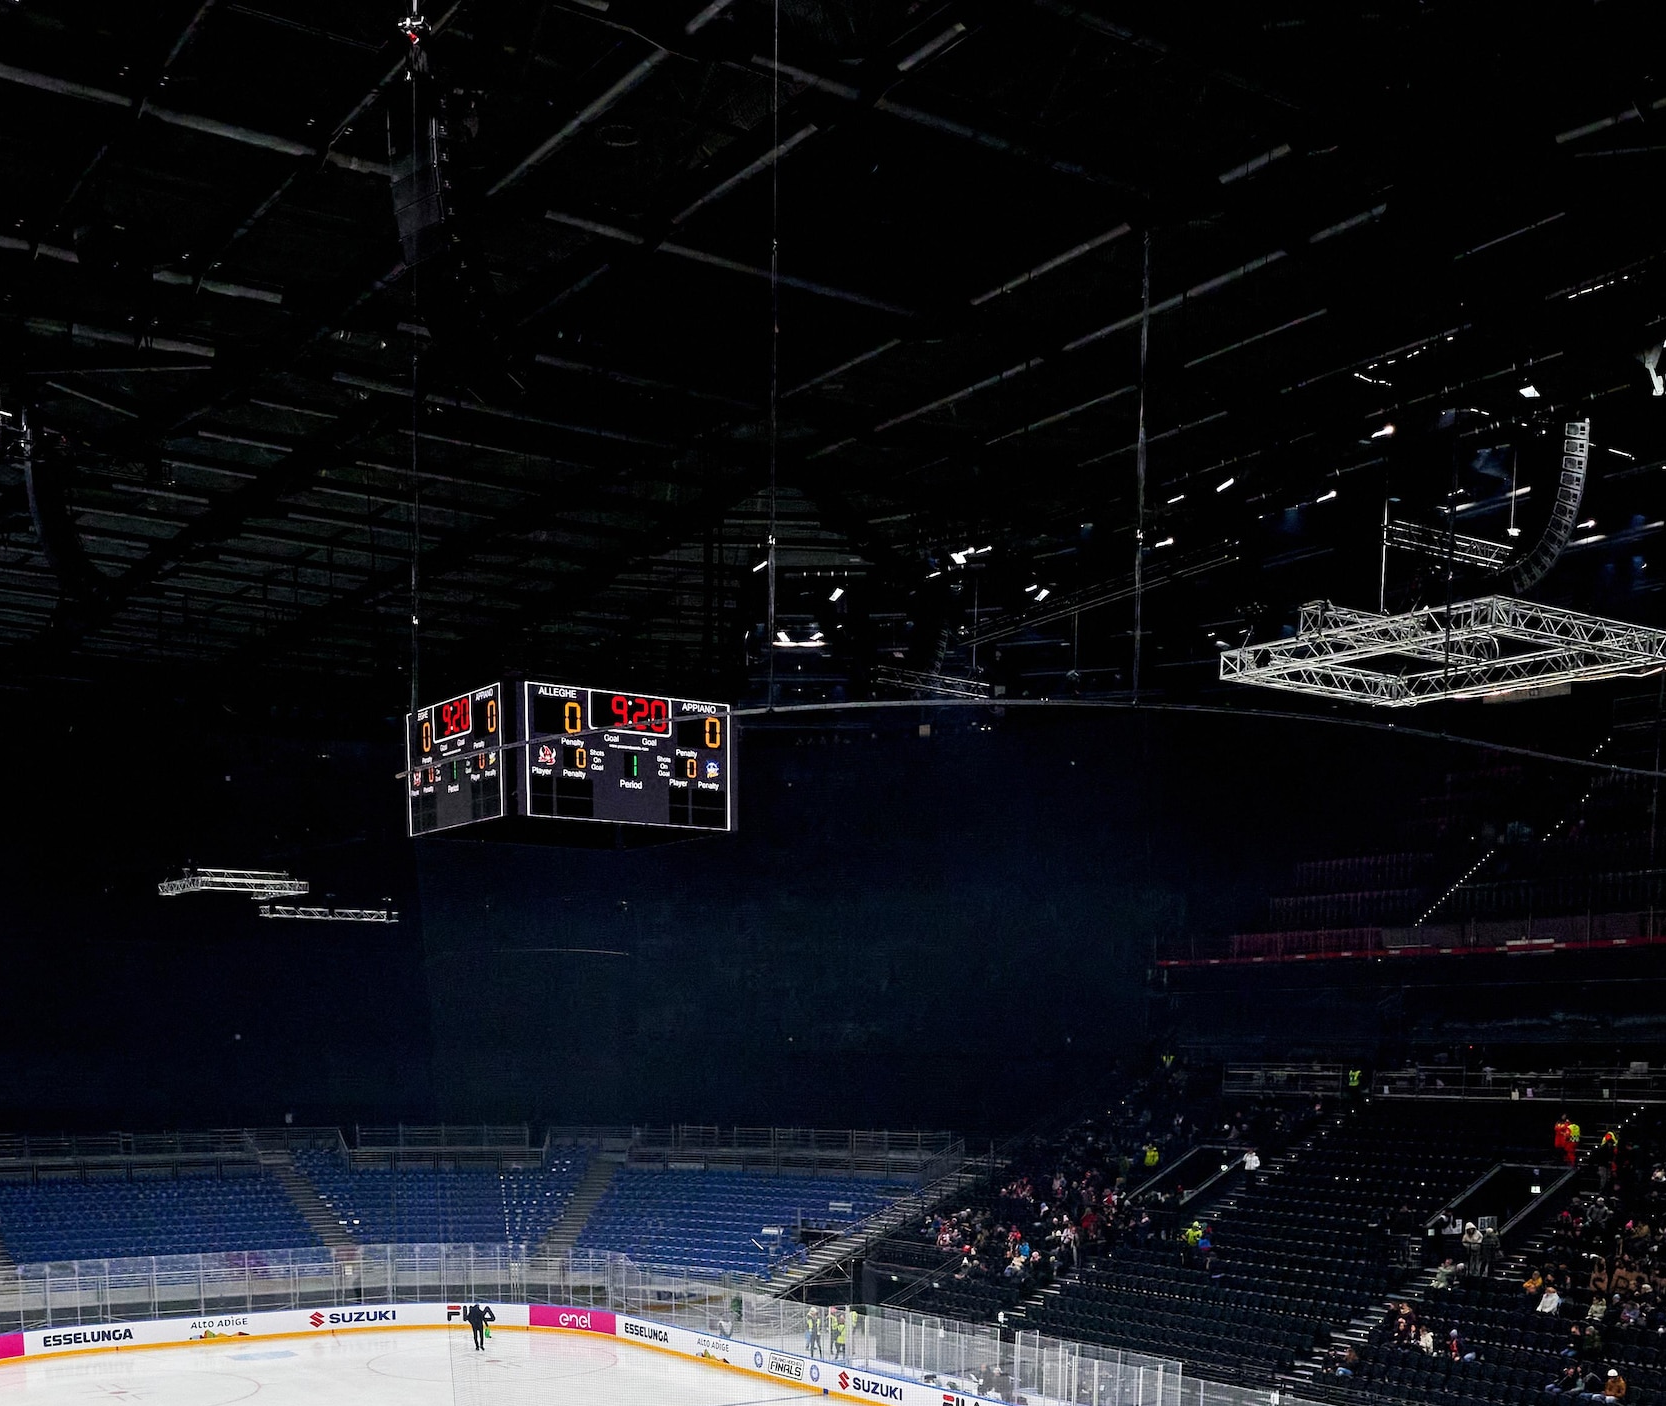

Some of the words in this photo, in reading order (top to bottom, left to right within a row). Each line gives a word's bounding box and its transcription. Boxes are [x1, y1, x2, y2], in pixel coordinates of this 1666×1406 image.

[538, 686, 577, 699] ALLEGHE
[442, 697, 470, 736] 9:20
[487, 700, 497, 733] 0
[611, 695, 667, 732] 9:20
[681, 702, 717, 715] APPIANO
[564, 701, 581, 734] 0
[422, 721, 432, 753] 0
[604, 734, 620, 743] Goal
[705, 716, 721, 748] 0
[561, 737, 585, 748] Penalty
[641, 737, 658, 747] Goal
[576, 747, 587, 769] 0
[675, 748, 698, 760] Penalty
[531, 766, 553, 777] Player
[562, 768, 587, 780] Penalty
[633, 754, 638, 777] 1
[686, 758, 697, 779] 0
[619, 779, 643, 790] Period
[669, 778, 689, 788] Player
[697, 780, 720, 791] Penalty
[329, 1309, 396, 1325] SUZUKI
[559, 1311, 592, 1330] enel
[43, 1328, 133, 1348] ESSELUNGA
[624, 1322, 669, 1344] ESSELUNGA
[770, 1361, 802, 1377] FINALS
[852, 1376, 903, 1402] SUZUKI
